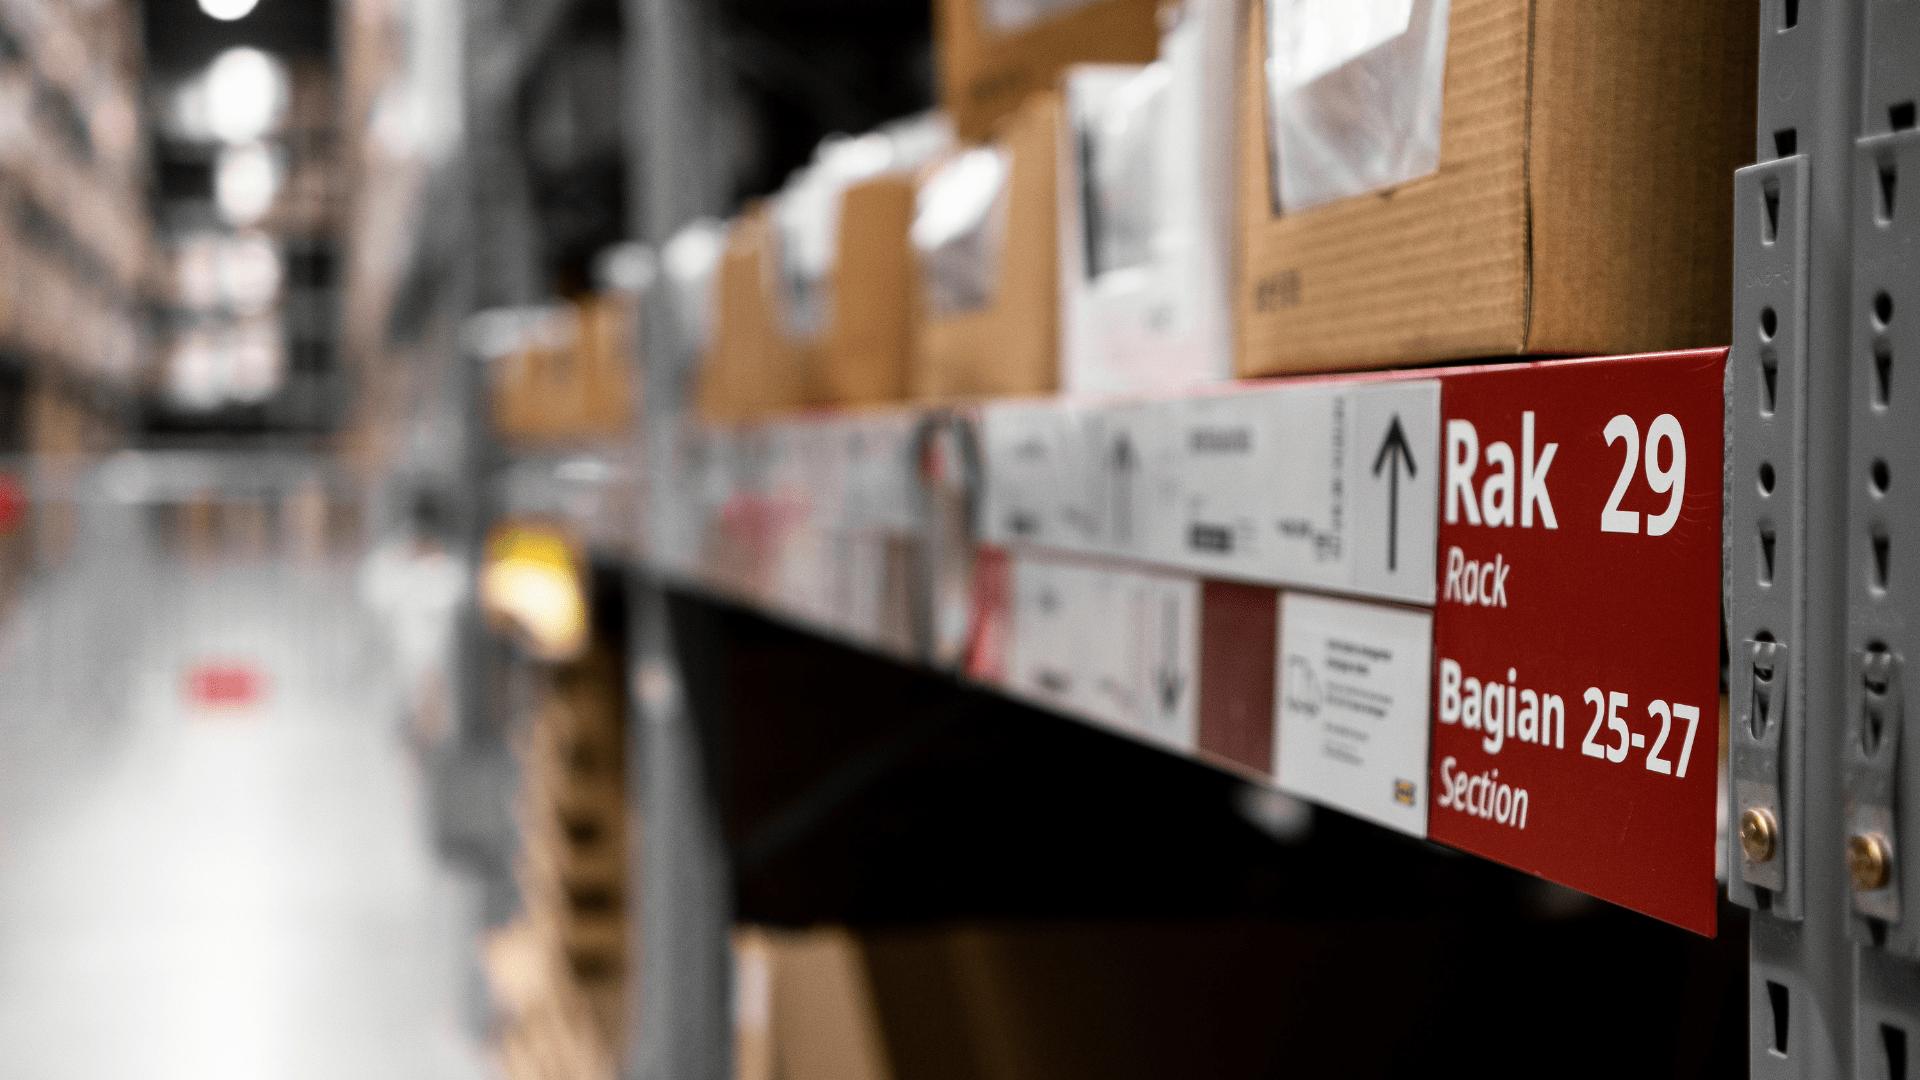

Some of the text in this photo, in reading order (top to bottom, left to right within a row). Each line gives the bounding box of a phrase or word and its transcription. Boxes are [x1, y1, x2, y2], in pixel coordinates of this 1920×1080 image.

[1445, 411, 1559, 530] Rak
[1601, 413, 1687, 537] 29
[1444, 546, 1510, 608] Rack
[1439, 658, 1565, 755] Bagian
[1582, 687, 1700, 779] 25-27
[1438, 756, 1529, 830] Section
